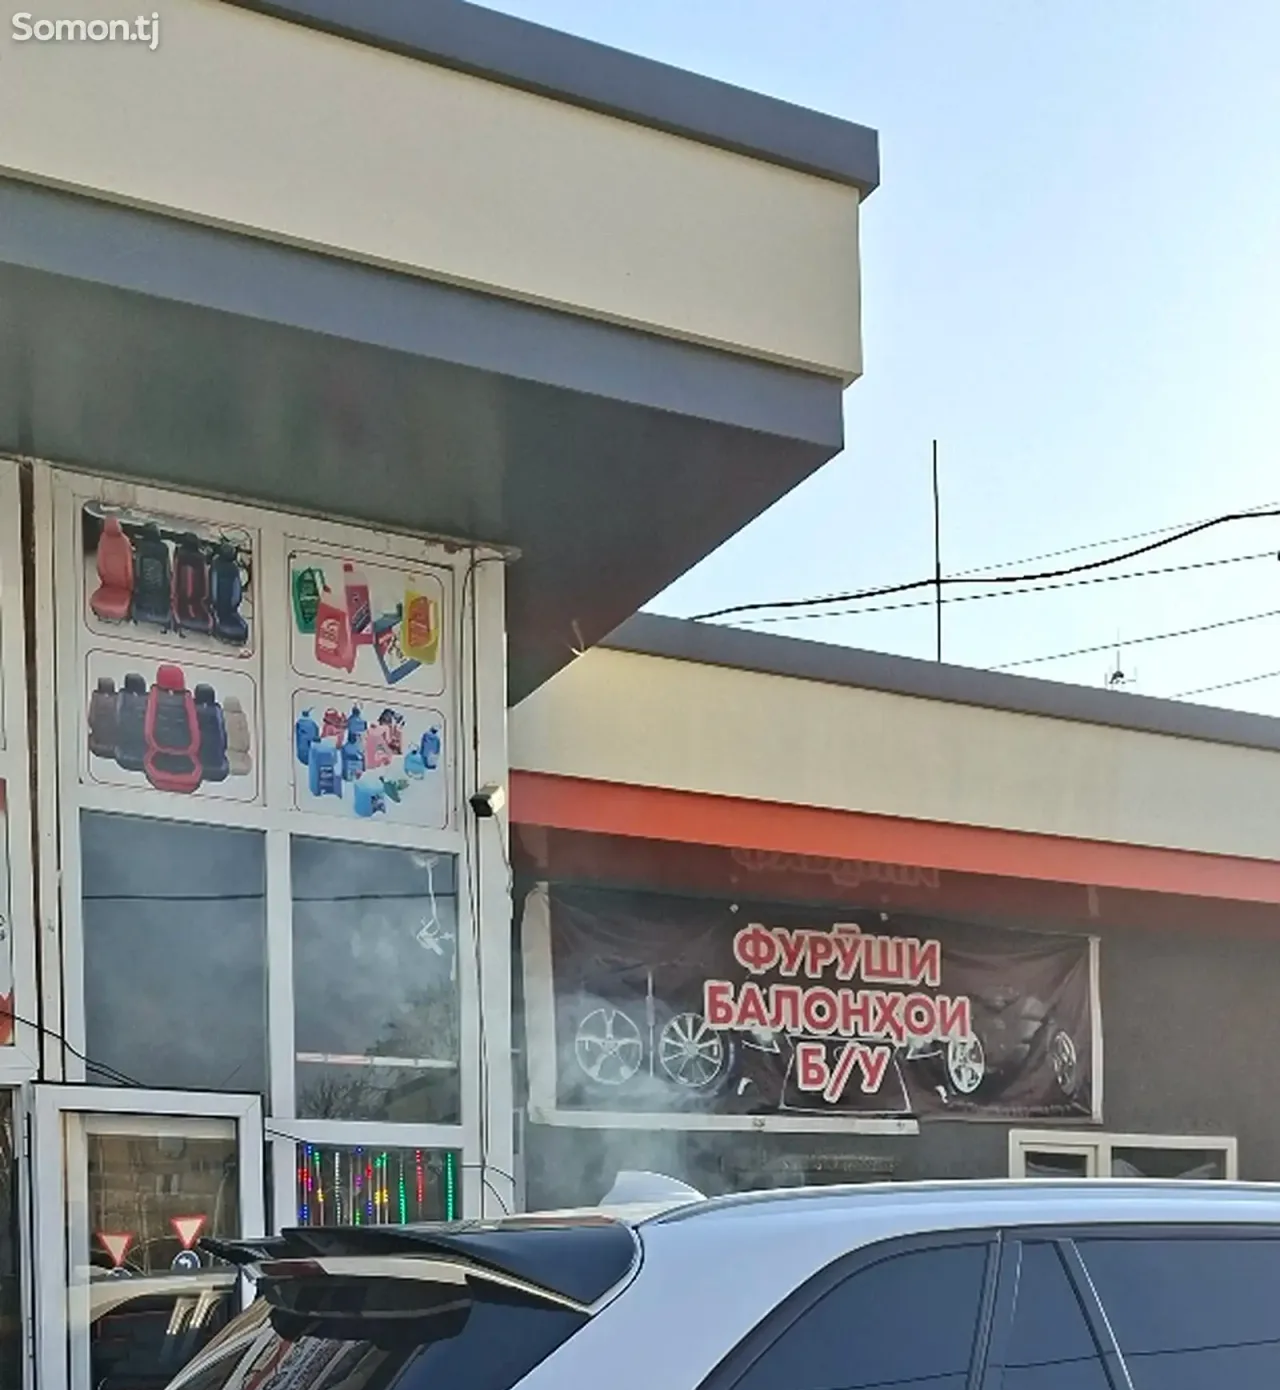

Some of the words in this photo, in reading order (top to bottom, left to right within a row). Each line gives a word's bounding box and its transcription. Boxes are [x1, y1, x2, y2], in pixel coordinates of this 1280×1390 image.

[734, 923, 941, 987] ФУРӮШИ
[703, 980, 973, 1047] БАЛОНҲОИ
[797, 1042, 892, 1103] Б/У
